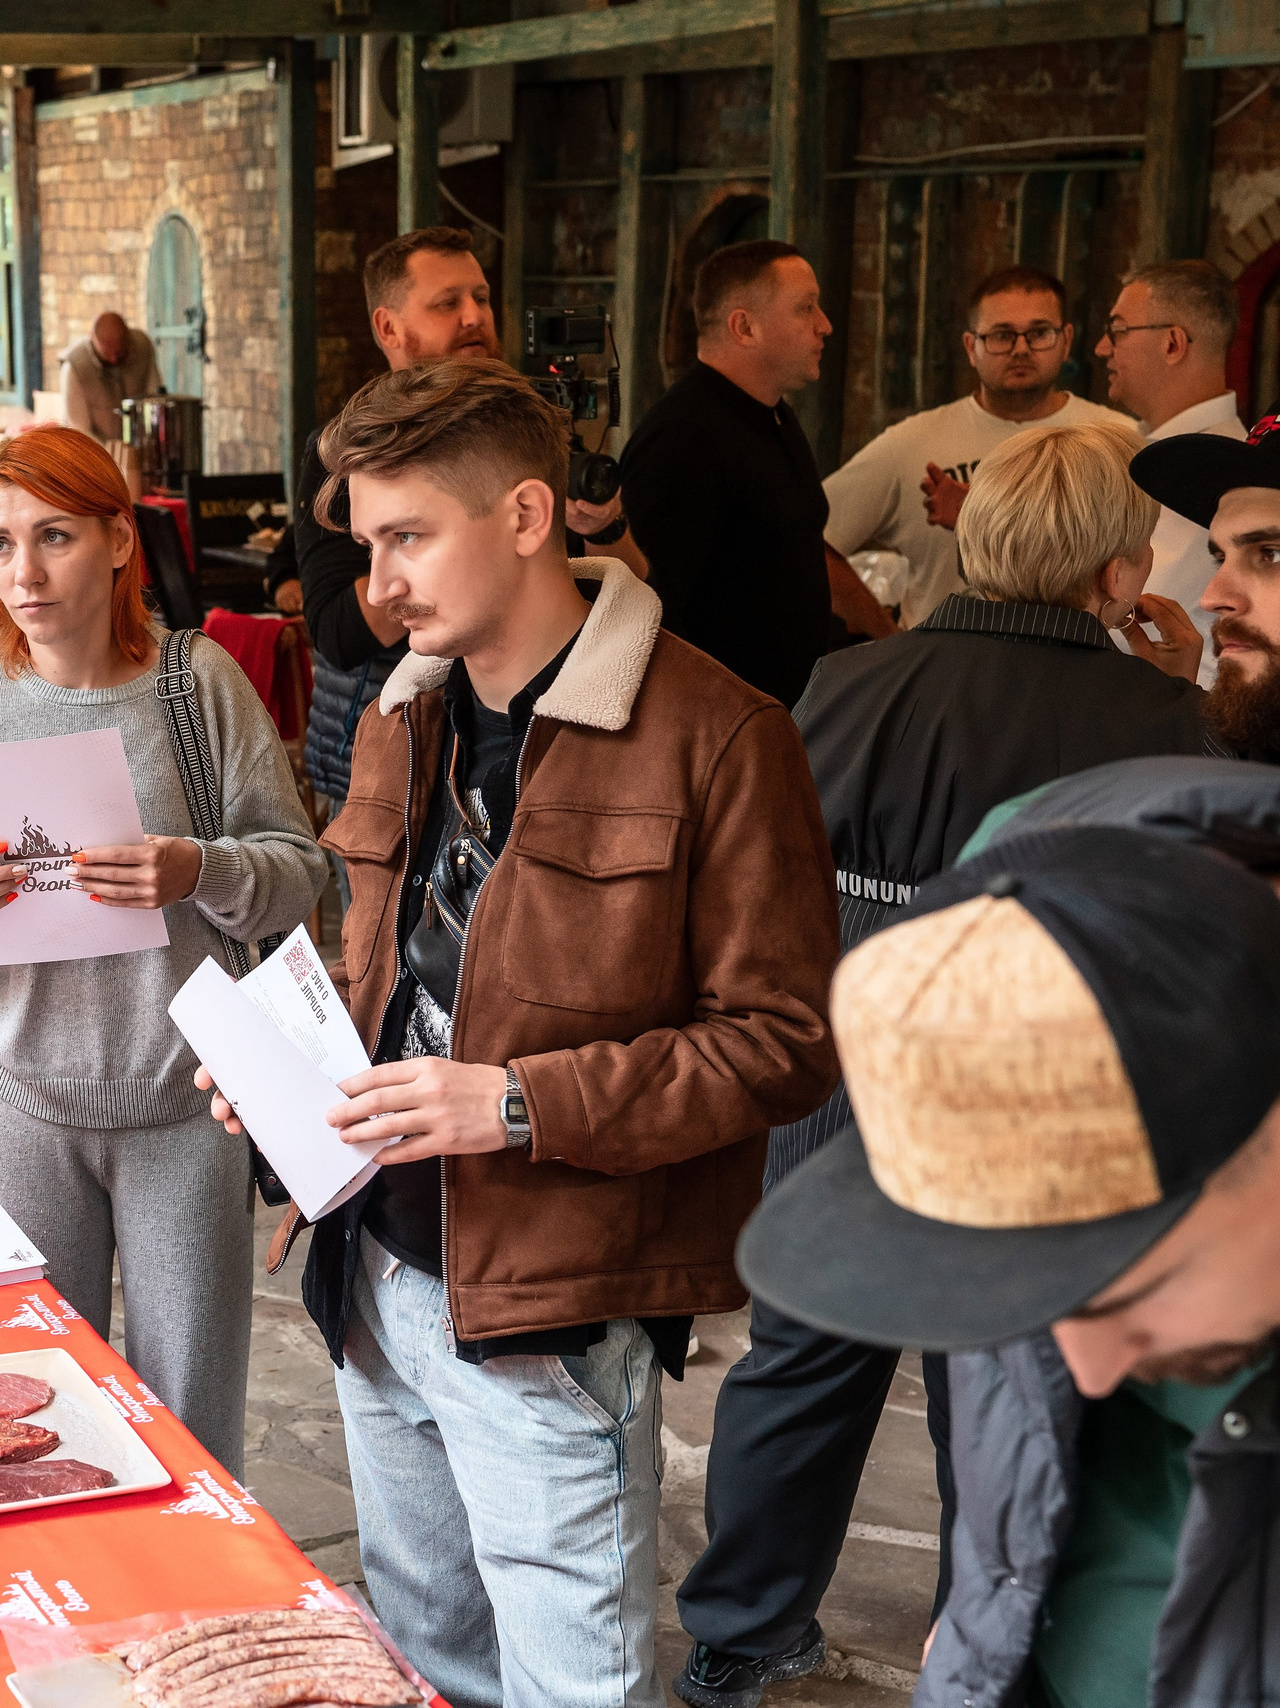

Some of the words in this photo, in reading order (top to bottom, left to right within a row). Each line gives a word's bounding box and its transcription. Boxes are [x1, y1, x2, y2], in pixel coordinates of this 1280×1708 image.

[22, 876, 71, 893] Огон
[310, 970, 325, 992] НАС
[300, 981, 327, 1025] БОЛЬШЕ
[321, 991, 329, 1001] О
